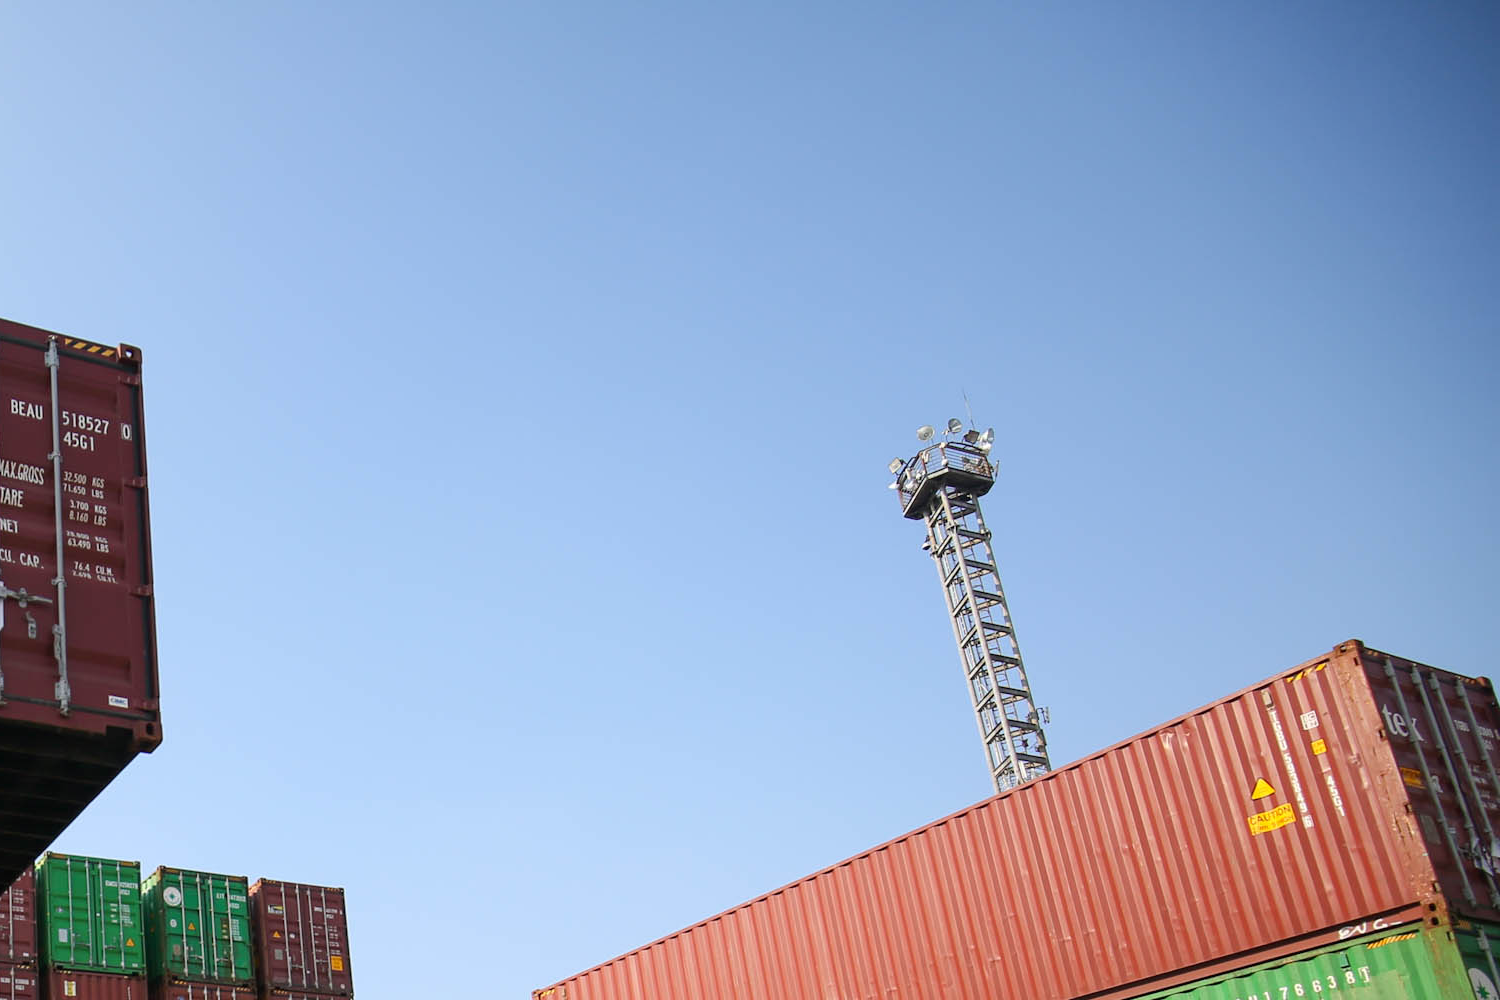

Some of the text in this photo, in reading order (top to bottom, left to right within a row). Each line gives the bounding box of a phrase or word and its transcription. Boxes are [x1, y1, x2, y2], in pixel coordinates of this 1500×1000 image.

[11, 399, 43, 420] BEAU
[62, 411, 110, 434] 518527
[63, 432, 95, 451] 45G1
[92, 477, 105, 488] KGS
[0, 487, 24, 507] TARE
[91, 489, 104, 499] LBS
[69, 500, 107, 515] 3.700 KGS
[0, 518, 19, 534] NET
[94, 516, 107, 526] LBS
[96, 543, 110, 553] LBS
[1250, 804, 1291, 825] CAUTION
